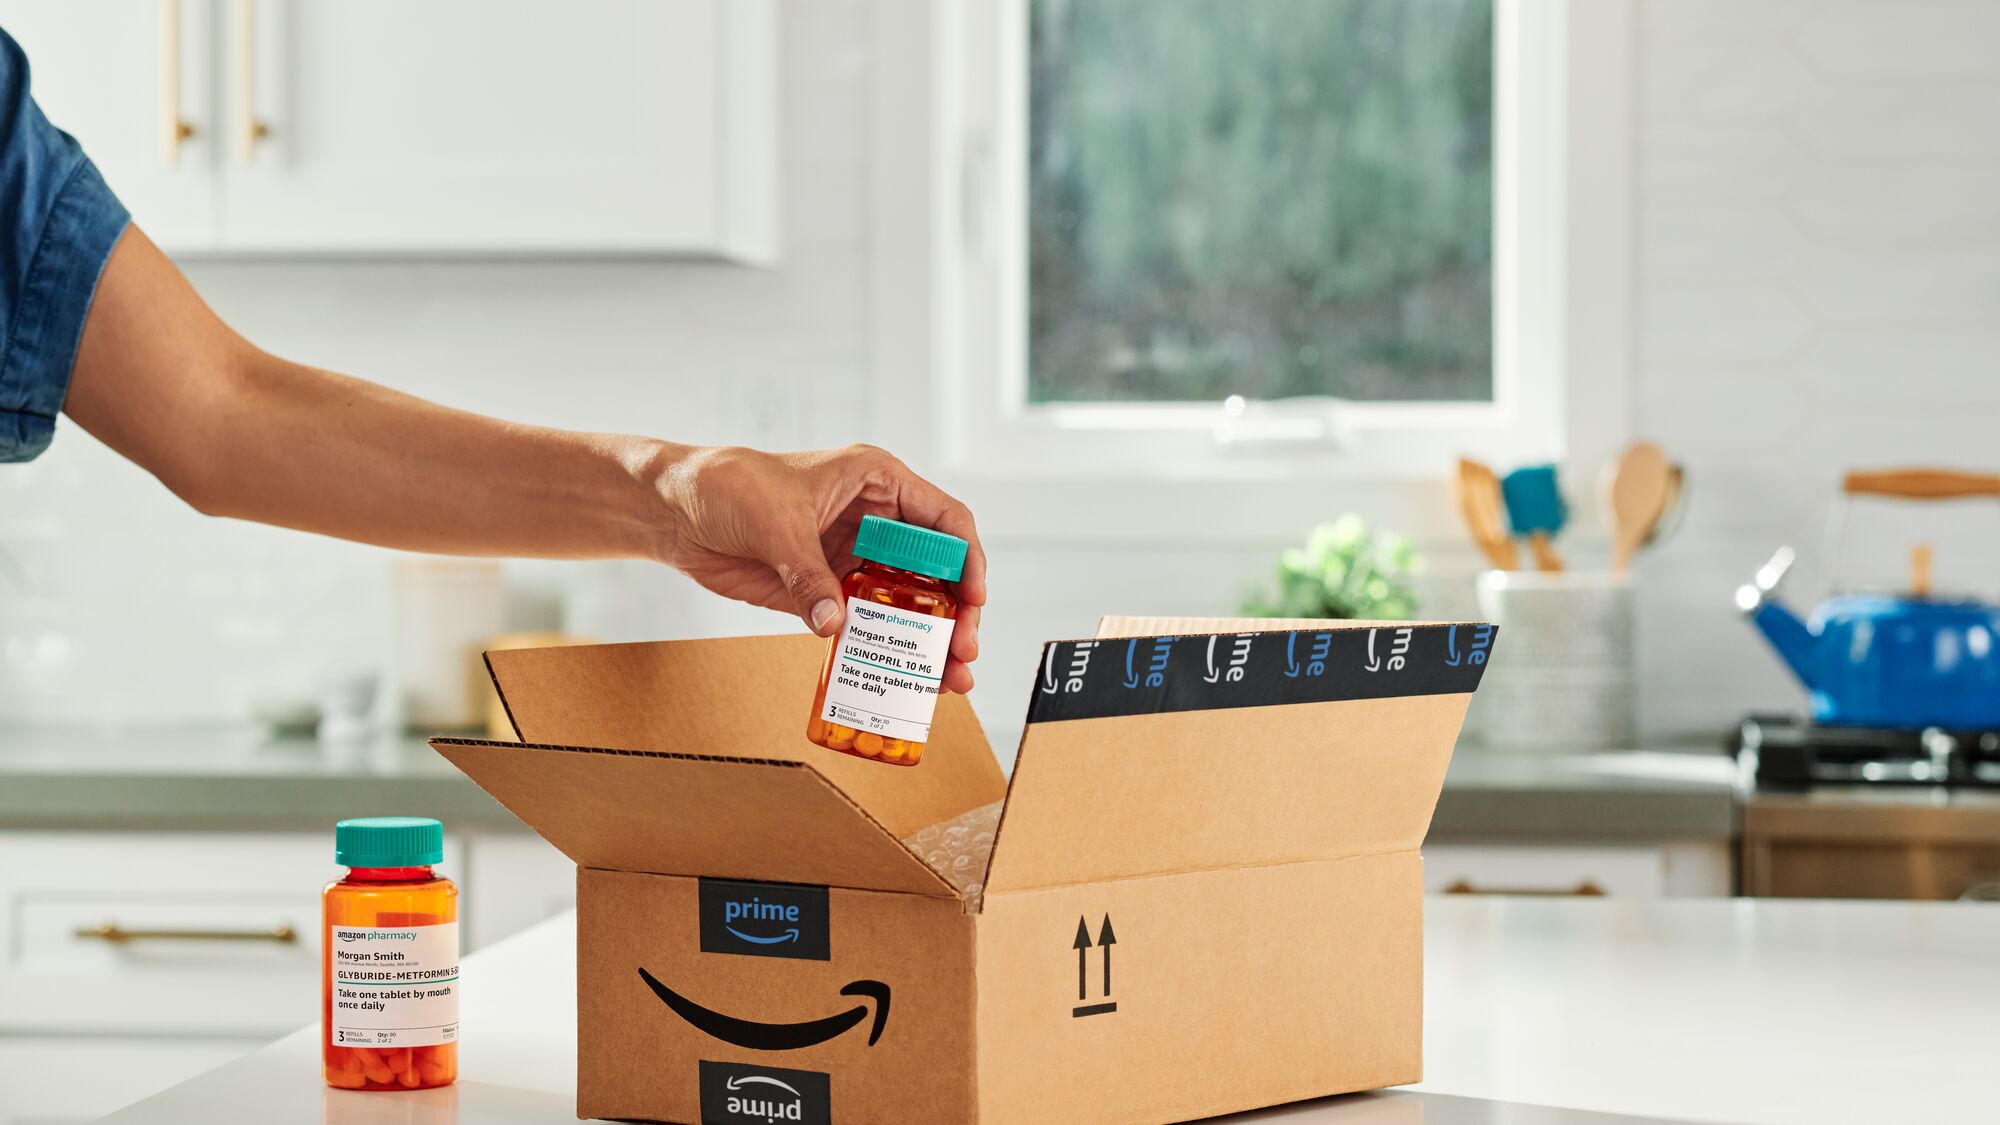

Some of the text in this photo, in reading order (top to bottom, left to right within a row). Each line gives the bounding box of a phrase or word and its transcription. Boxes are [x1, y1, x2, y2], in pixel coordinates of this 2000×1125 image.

[855, 606, 933, 633] amazon pharmacy
[849, 625, 917, 650] Morgan Smith
[844, 645, 932, 674] LISINOPRIL 10 MG
[841, 664, 861, 677] Take
[862, 671, 882, 682] one
[884, 675, 913, 690] tablet
[914, 682, 925, 694] by
[838, 676, 887, 696] once daily
[829, 705, 837, 717] 3
[838, 707, 857, 717] REFILLS
[837, 713, 864, 725] REMAINING
[870, 716, 882, 724] Qty:
[725, 897, 800, 923] prime
[337, 931, 417, 941] amazon pharmacy
[337, 951, 405, 962] Morgan Smith
[338, 968, 450, 981] GLYBURIDE-METFORMIN
[338, 987, 451, 1000] Take one tablet by mouth
[338, 1001, 385, 1012] once daily
[338, 1031, 345, 1041] 3
[727, 1097, 801, 1123] prime
